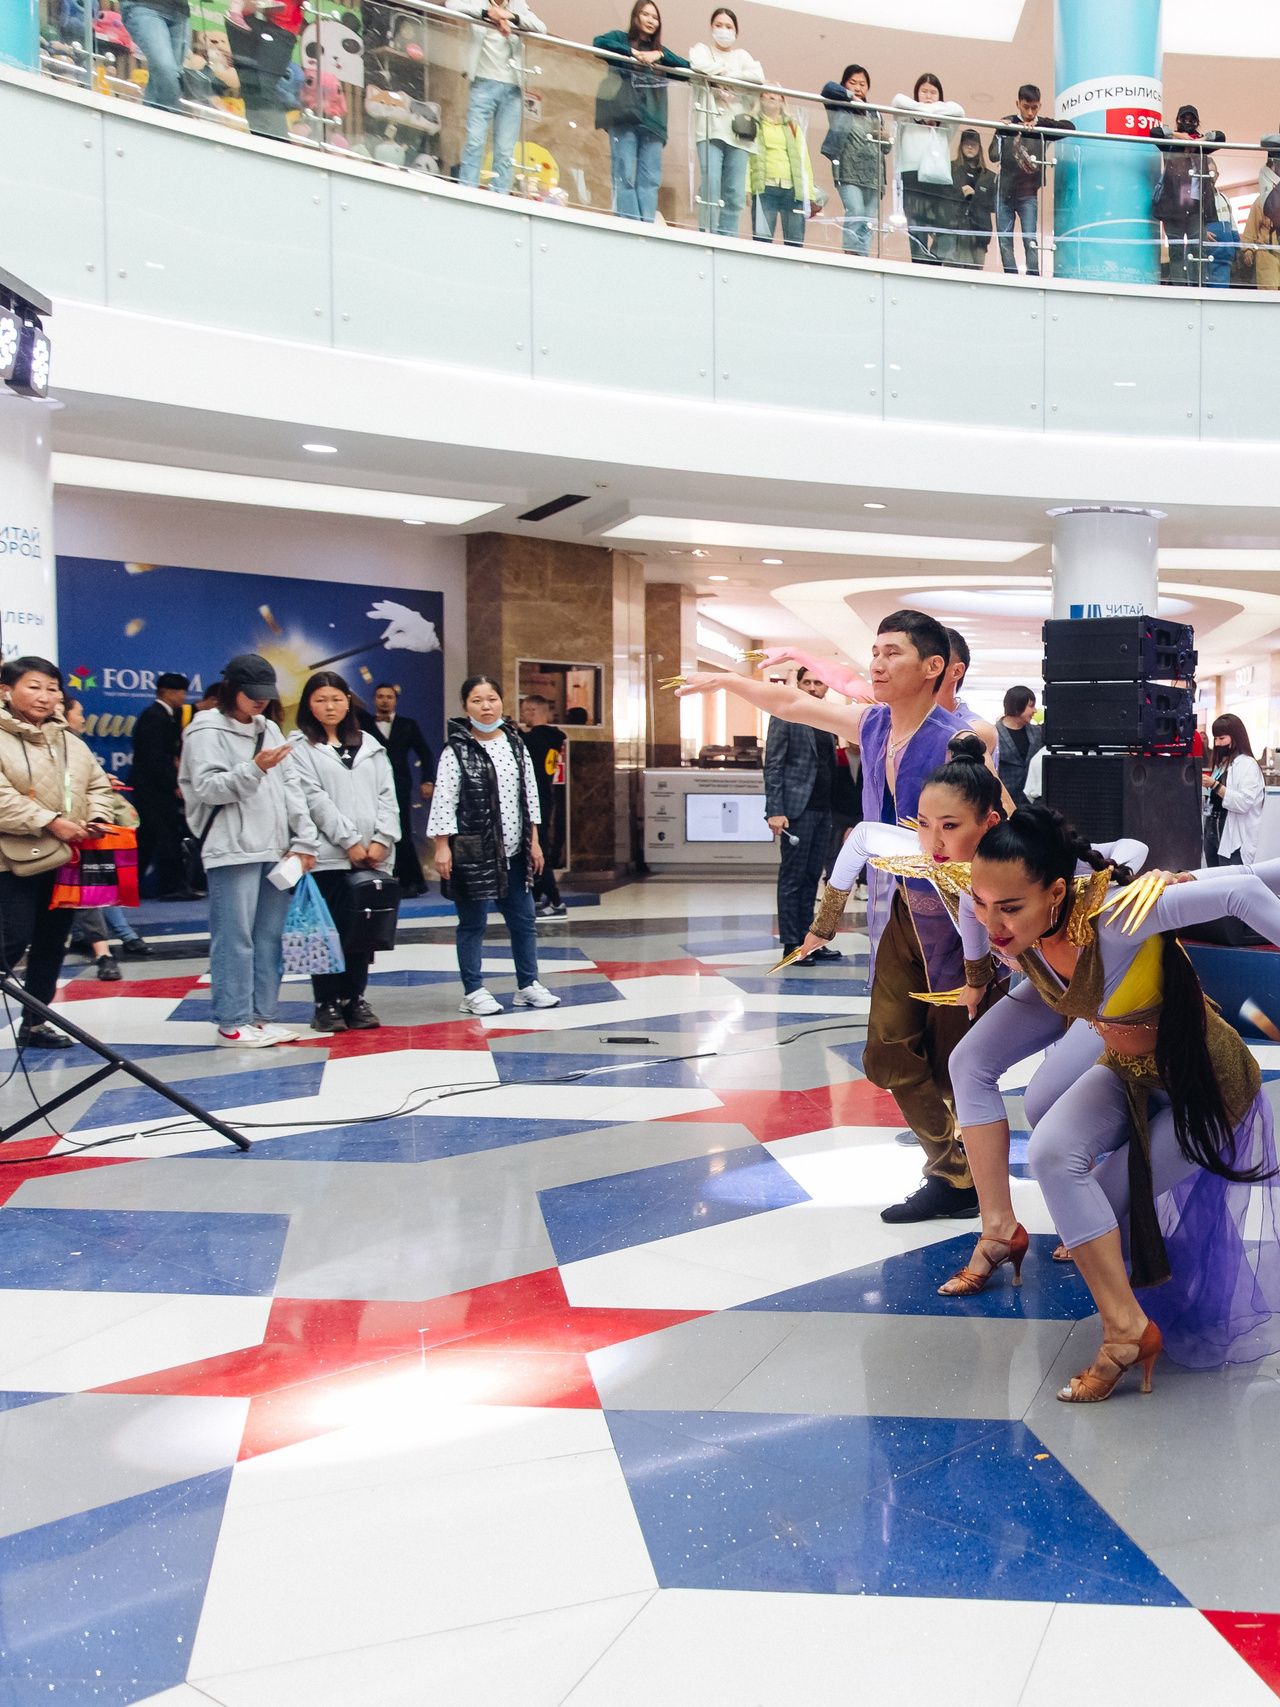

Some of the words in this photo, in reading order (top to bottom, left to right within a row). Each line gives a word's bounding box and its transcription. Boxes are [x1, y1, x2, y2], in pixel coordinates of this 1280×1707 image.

[1061, 94, 1081, 113] МЫ
[1125, 114, 1135, 129] 3
[1105, 602, 1144, 616] ЧИТАЙ
[102, 667, 204, 693] FORM
